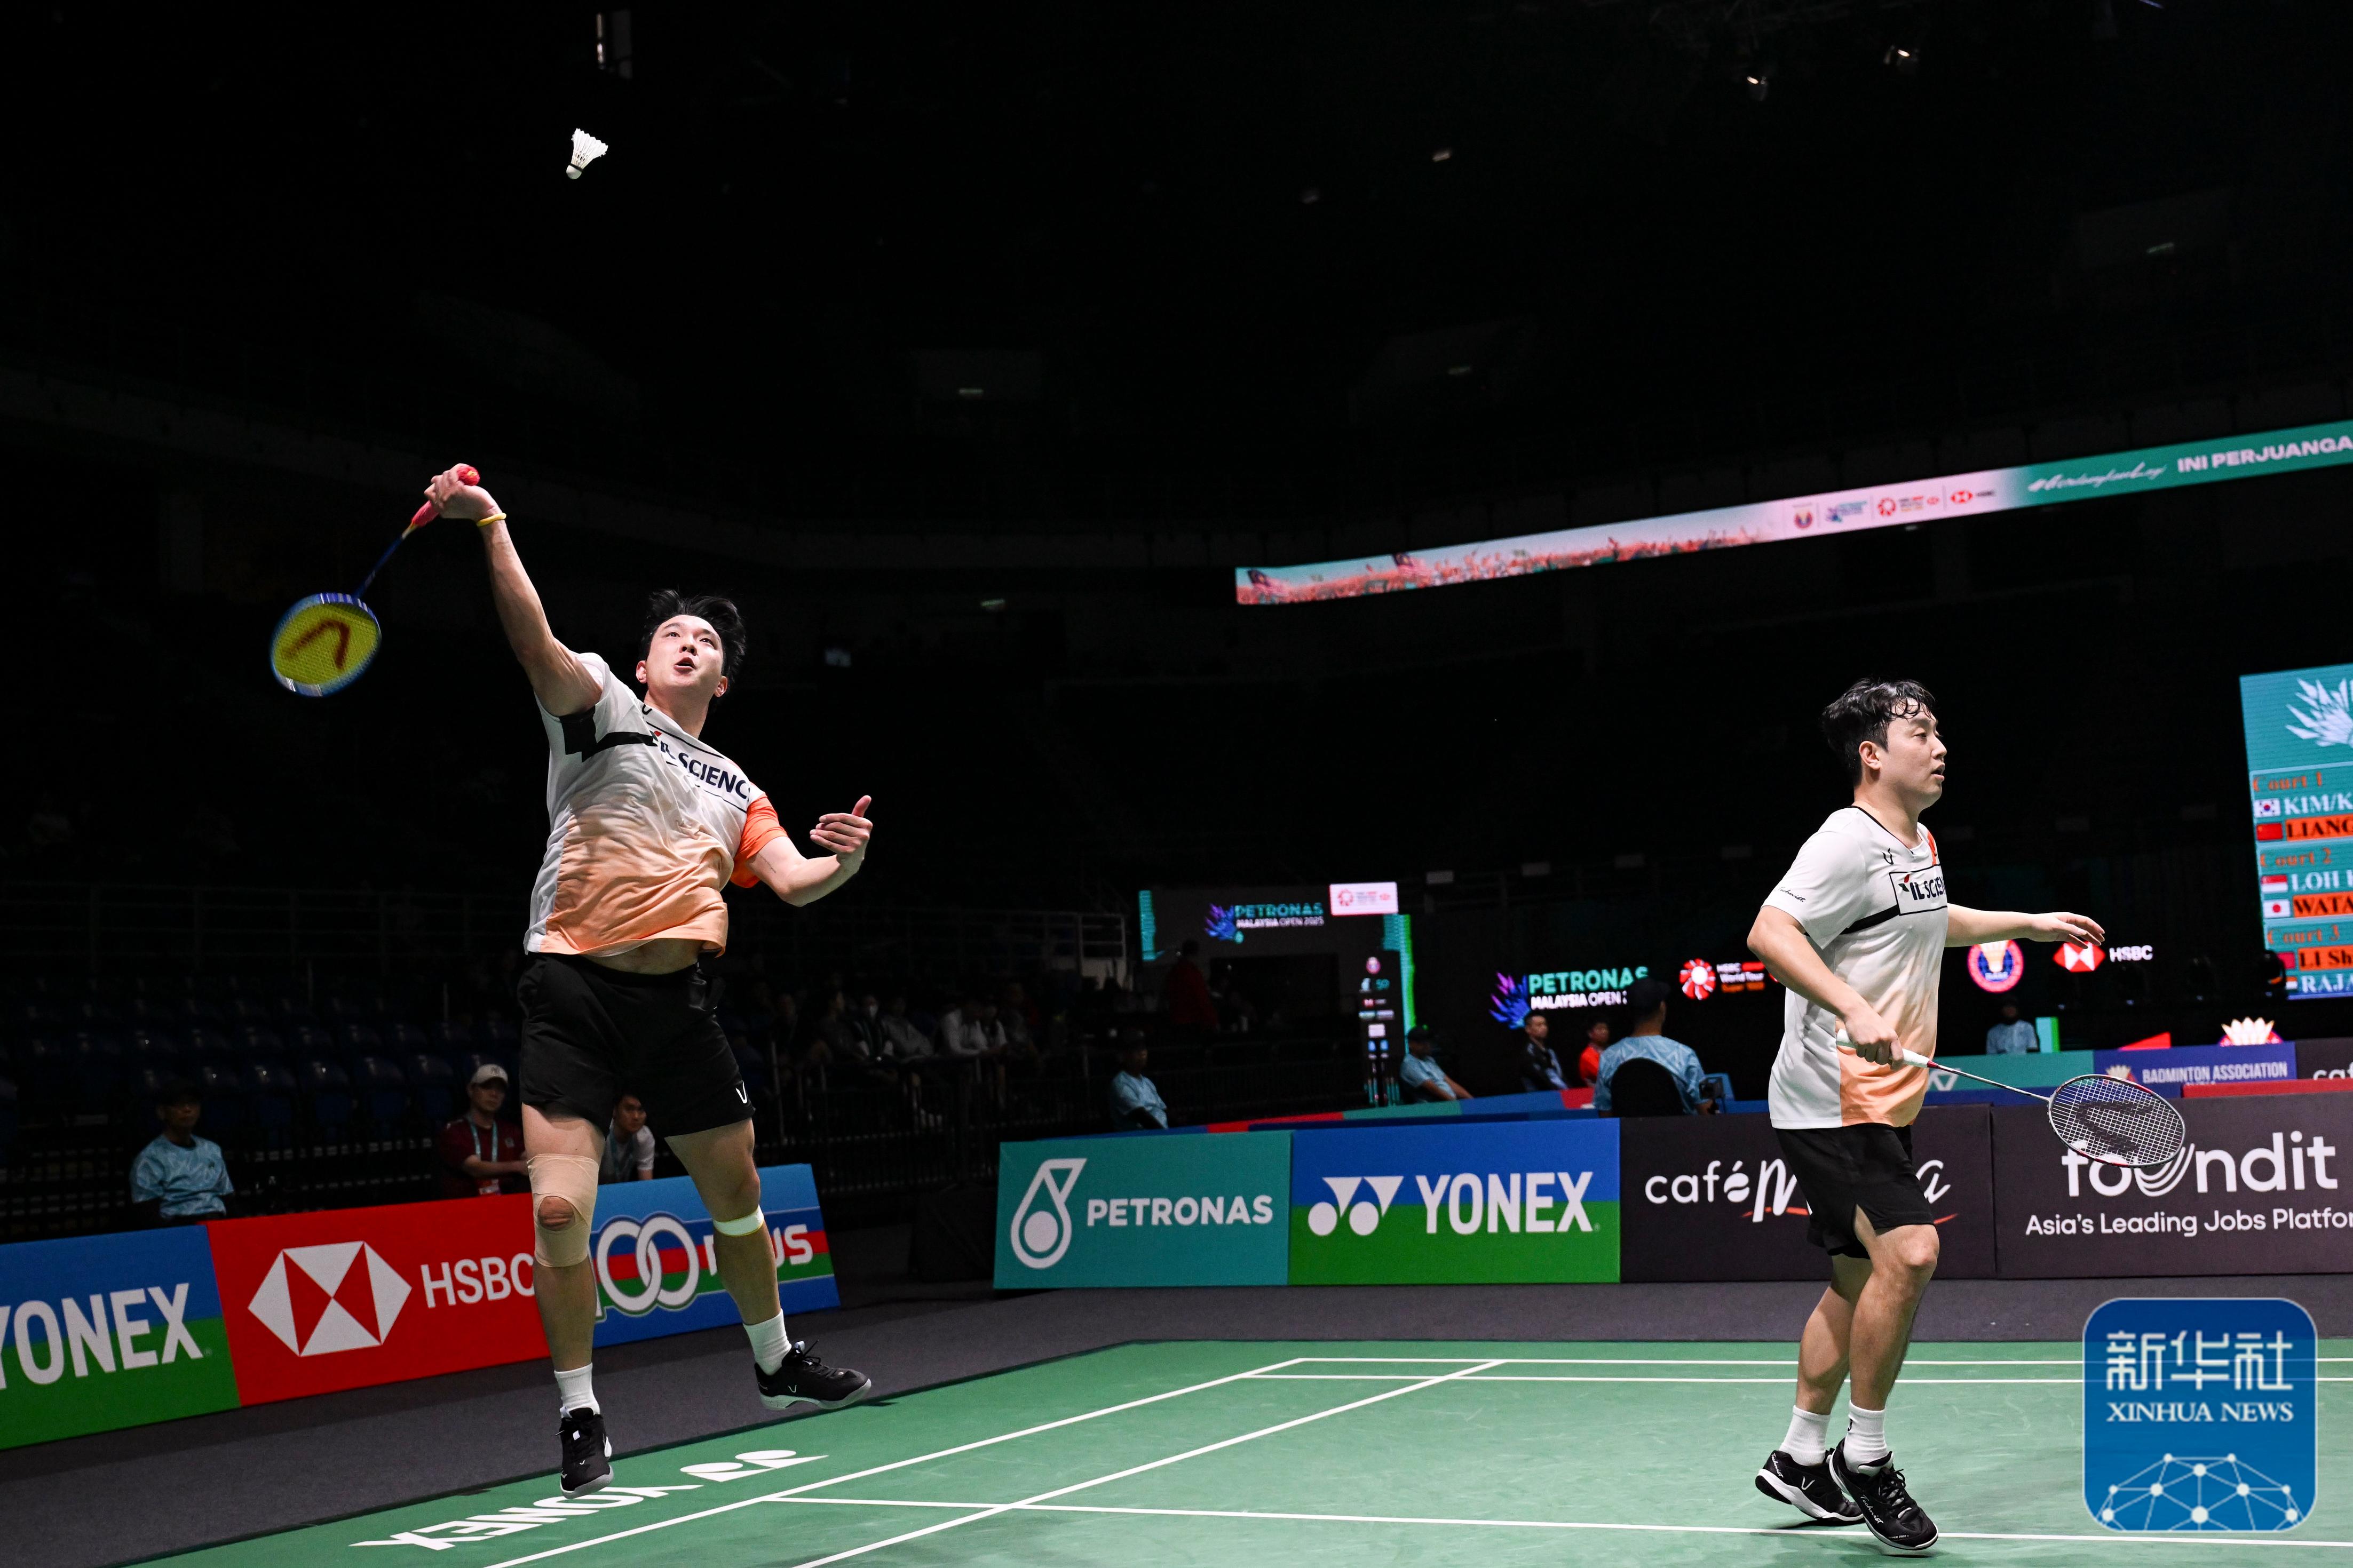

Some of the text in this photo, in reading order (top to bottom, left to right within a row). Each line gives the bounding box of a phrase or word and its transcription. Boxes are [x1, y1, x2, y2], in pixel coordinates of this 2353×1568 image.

[2177, 456, 2208, 473] INI
[678, 752, 750, 802] SCIENC
[2253, 774, 2307, 792] Court
[2260, 847, 2332, 867] Court 2
[1910, 882, 1925, 901] IL
[2291, 870, 2340, 892] LOH
[1234, 902, 1324, 918] PETRONAS
[1236, 918, 1279, 929] MALAYSIA
[1279, 917, 1303, 927] OPEN
[2267, 924, 2340, 944] Court 3
[2109, 945, 2153, 962] HSBC
[1531, 993, 1588, 1010] MALAYSIA
[1588, 991, 1621, 1007] OPEN
[2142, 1061, 2288, 1084] BADMINTON ASSOCIATION
[2061, 1130, 2338, 1197] foundit
[1087, 1195, 1273, 1227] PETRONAS
[1415, 1171, 1593, 1235] YONEX
[2025, 1213, 2094, 1236] Asia's
[2100, 1212, 2198, 1237] Leading
[2204, 1209, 2267, 1231] Jobs
[420, 1252, 535, 1309] HSBC
[348, 1484, 704, 1550] YONEX
